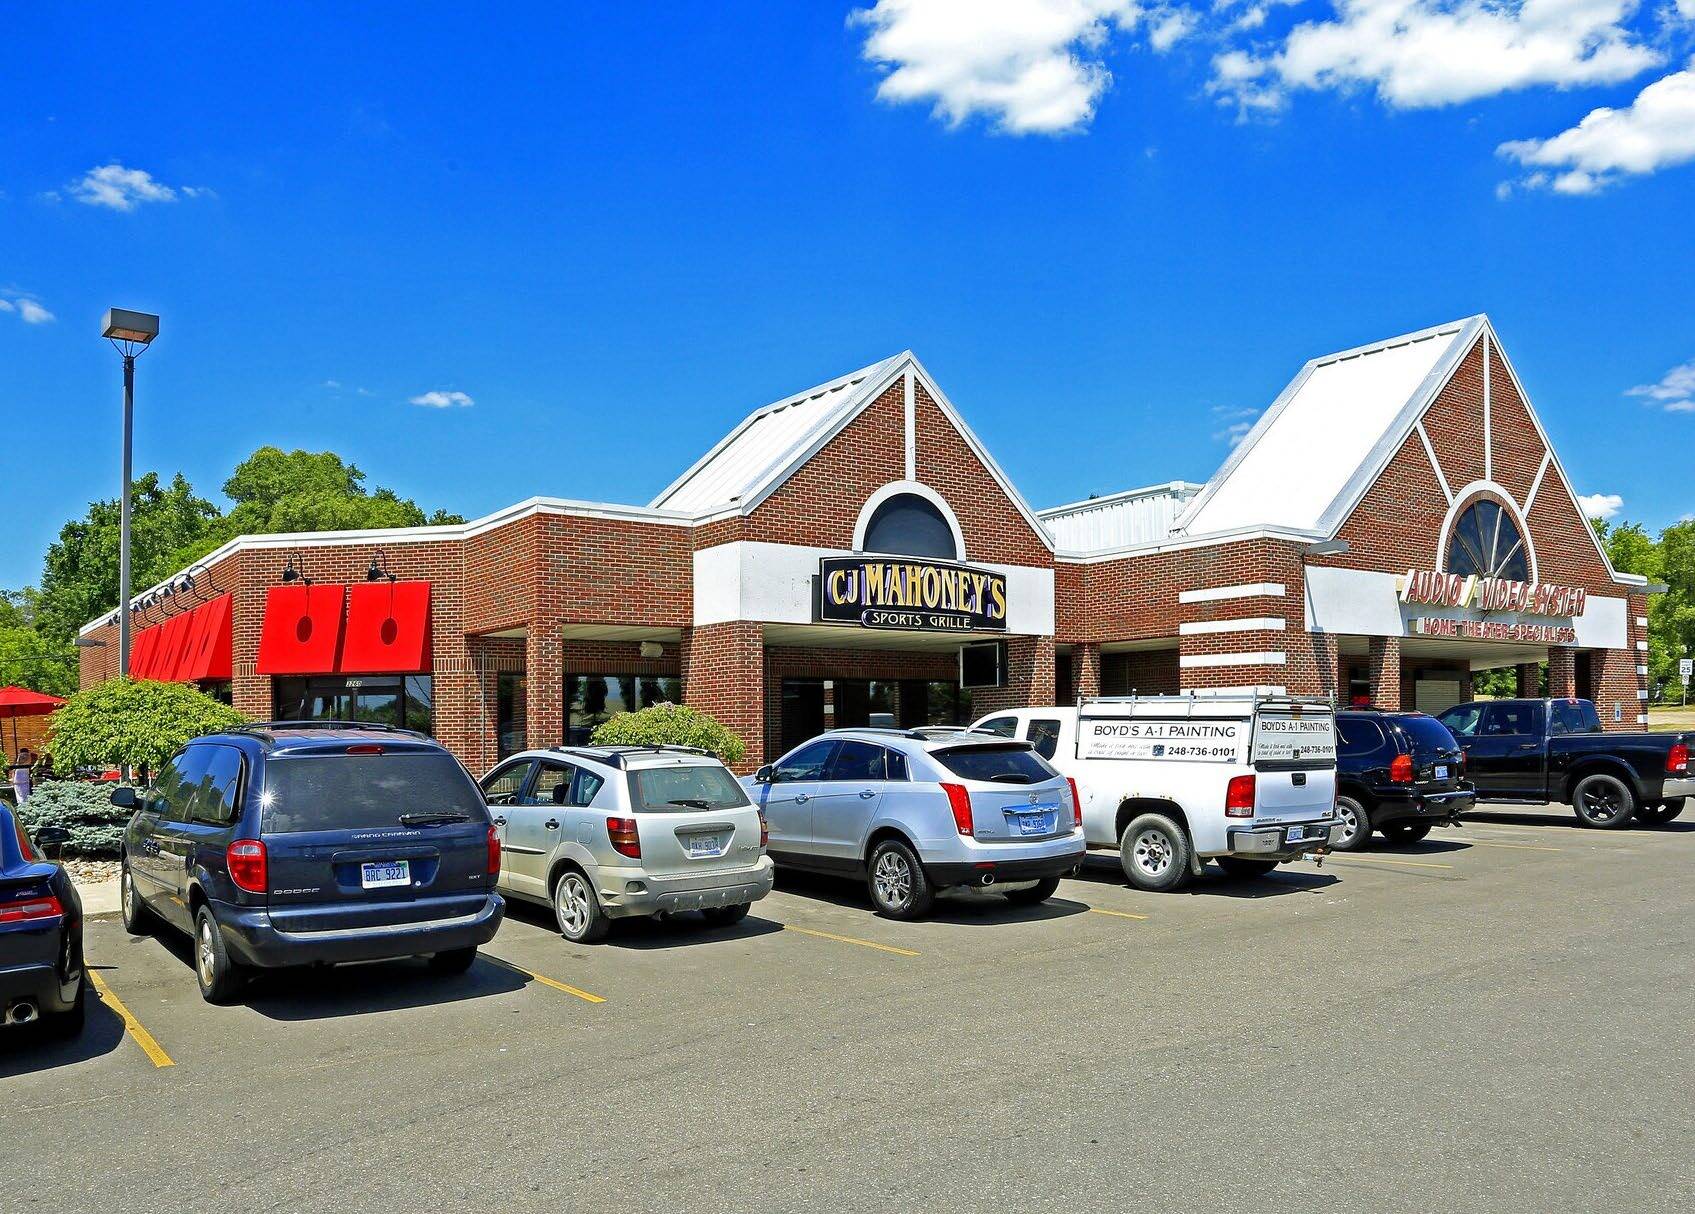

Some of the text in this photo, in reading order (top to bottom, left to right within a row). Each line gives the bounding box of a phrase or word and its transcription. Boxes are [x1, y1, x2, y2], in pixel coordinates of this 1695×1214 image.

[829, 563, 1006, 620] CJ MAHONEY'S
[1402, 570, 1463, 608] AUDIO
[1478, 577, 1529, 613] VIDEO
[871, 611, 971, 629] SPORTS GRILLE
[1422, 617, 1576, 643] HOME THEATER SPECIALISTS
[1681, 666, 1691, 674] 25
[1093, 725, 1140, 737] BOYD'S
[1168, 725, 1236, 738] PAINTING
[1261, 721, 1330, 732] BOYD'S A-1 PAINTING
[1168, 746, 1236, 757] 248-736-0101
[273, 887, 321, 896] DODGE
